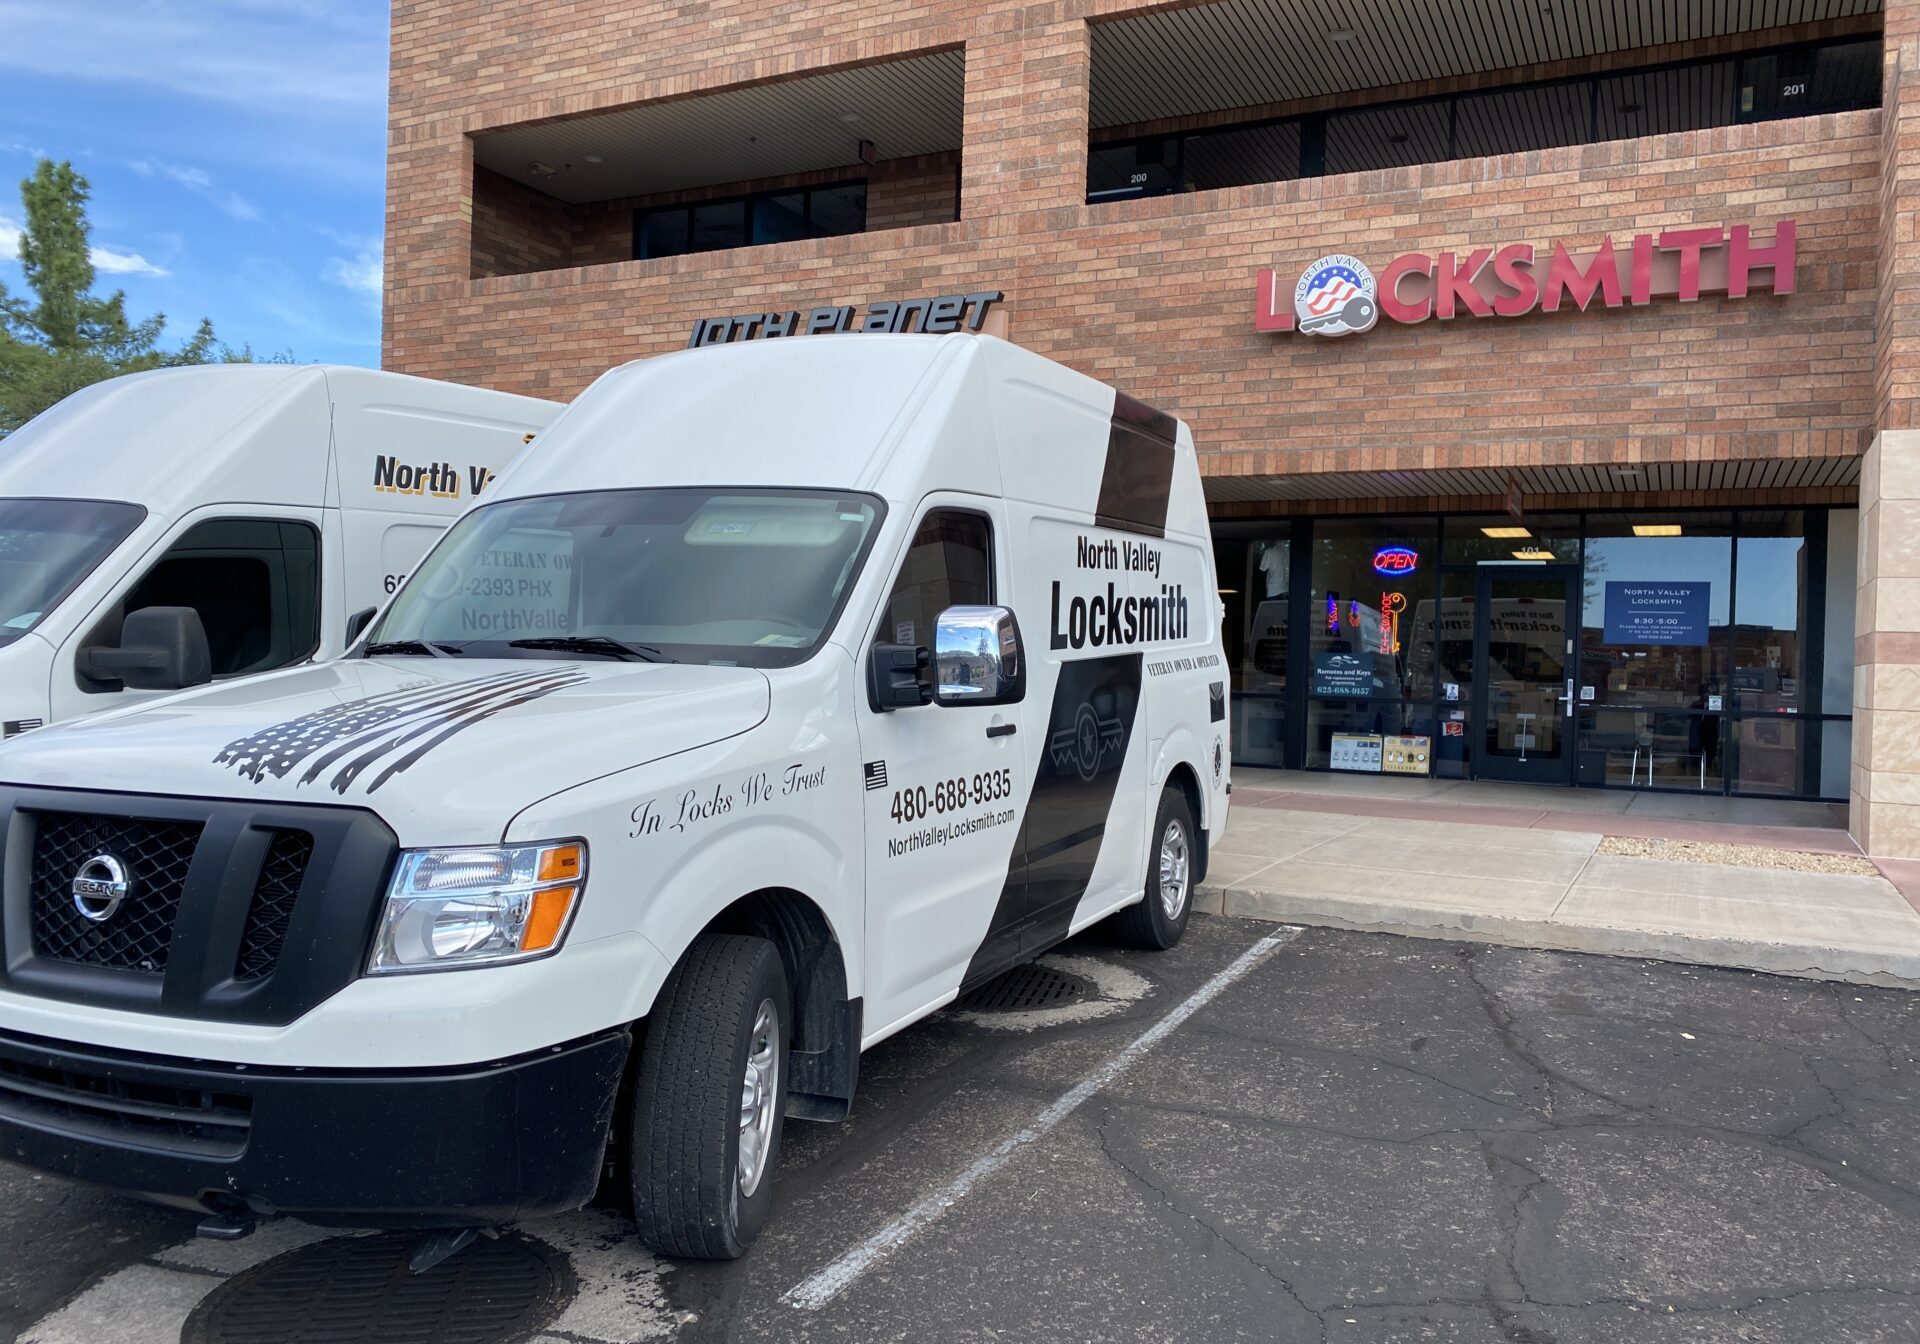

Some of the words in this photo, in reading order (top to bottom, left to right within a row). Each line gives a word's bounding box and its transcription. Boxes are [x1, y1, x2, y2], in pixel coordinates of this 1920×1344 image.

[1783, 84, 1805, 96] 201
[1130, 173, 1147, 184] 200
[1296, 258, 1329, 302] NORTH
[1335, 255, 1372, 295] VALLEY
[373, 454, 459, 497] North
[1077, 535, 1118, 570] North
[1122, 540, 1161, 579] Valley
[1374, 553, 1418, 569] OPEN
[1521, 546, 1540, 556] 101
[518, 580, 552, 597] PHX
[1624, 588, 1654, 596] NORTH
[1657, 588, 1691, 596] VALLEY
[1050, 580, 1188, 650] Locksmith
[1147, 660, 1175, 677] VETERAN
[1174, 657, 1192, 673] OWNED
[1196, 654, 1220, 669] OPERATED
[1317, 668, 1343, 676] Remotes
[1356, 669, 1371, 677] Keys
[629, 798, 662, 839] In
[669, 784, 733, 833] Locks
[741, 772, 773, 807] We
[782, 763, 826, 796] Trust
[891, 768, 1011, 824] 480-688-9335
[889, 809, 1015, 858] NorthValleyLocksmith.com
